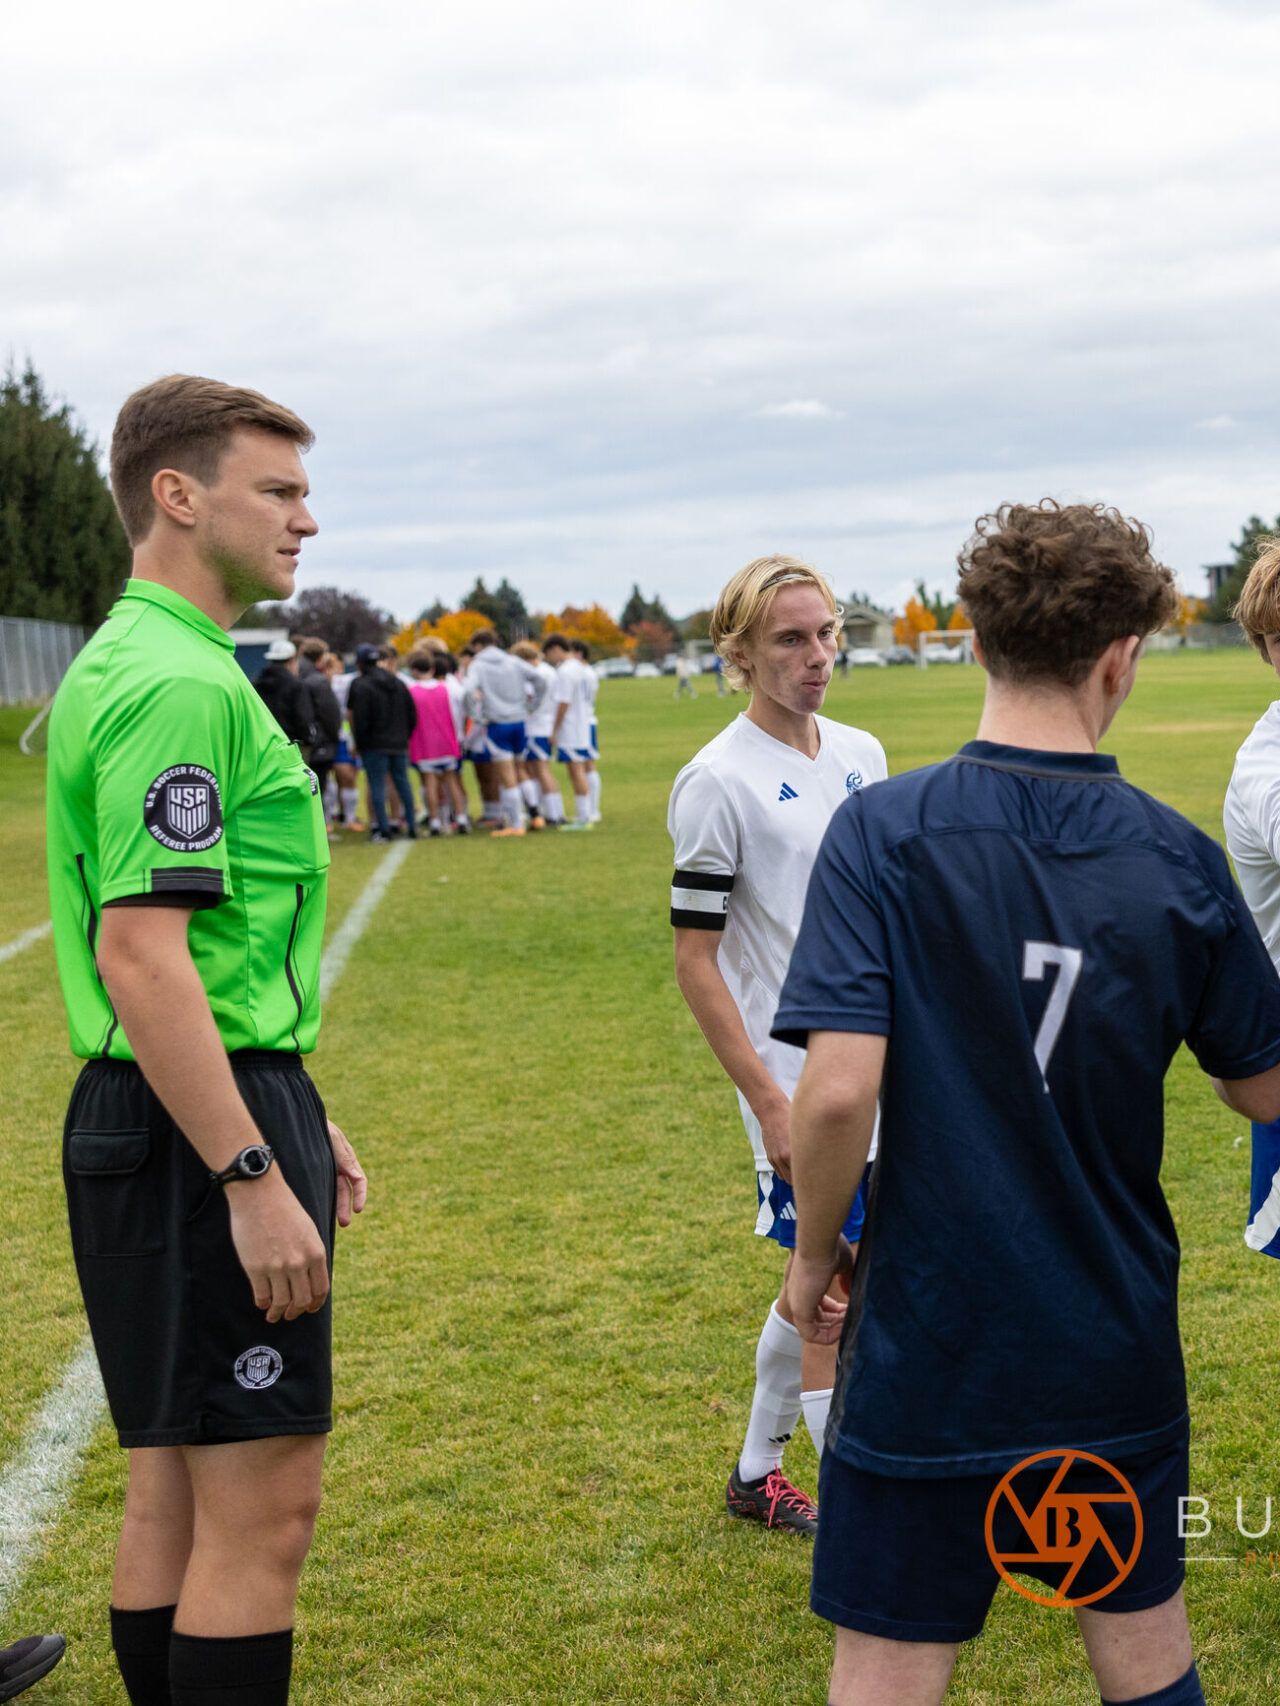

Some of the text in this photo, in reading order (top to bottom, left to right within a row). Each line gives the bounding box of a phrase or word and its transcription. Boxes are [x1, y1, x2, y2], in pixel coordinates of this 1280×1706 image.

[153, 766, 187, 789] SOCCER
[169, 787, 207, 808] USA
[150, 824, 187, 851] REFEREE
[1022, 939, 1083, 1094] 7
[250, 1357, 269, 1368] USA
